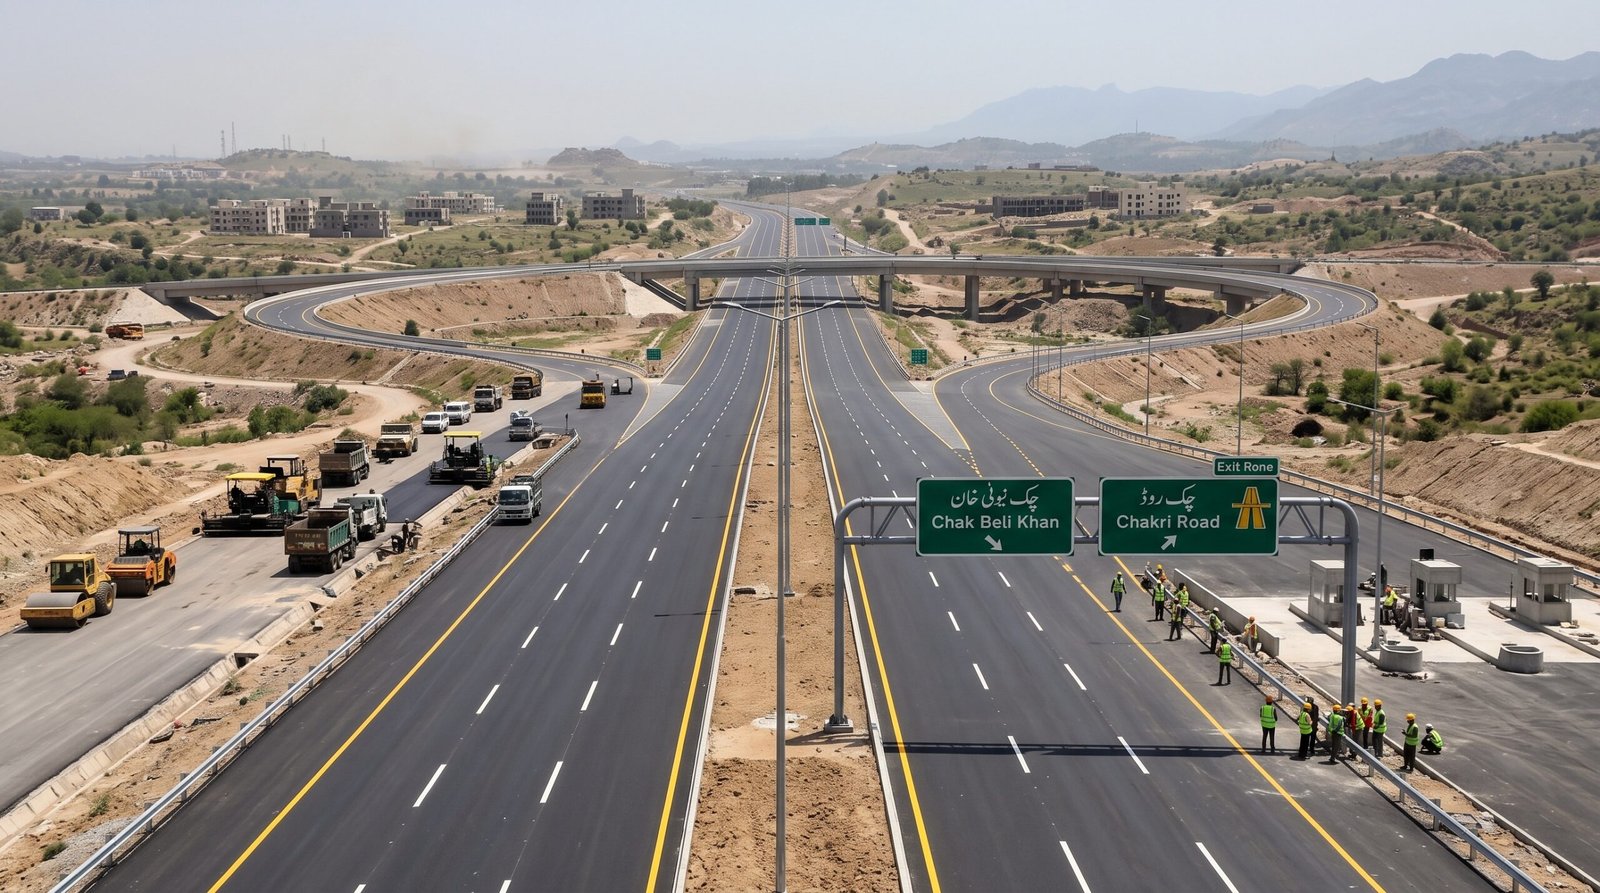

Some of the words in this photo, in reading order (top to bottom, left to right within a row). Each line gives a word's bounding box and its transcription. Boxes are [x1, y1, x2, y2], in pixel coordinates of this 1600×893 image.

[1217, 461, 1241, 472] Exit
[1243, 461, 1274, 472] Rone
[950, 489, 978, 509] خان
[1139, 487, 1163, 505] روڈ
[931, 515, 975, 529] Chak
[980, 515, 1012, 529] Beli
[1017, 515, 1059, 529] Khan
[1116, 514, 1171, 529] Chakri
[1177, 514, 1220, 529] Road
